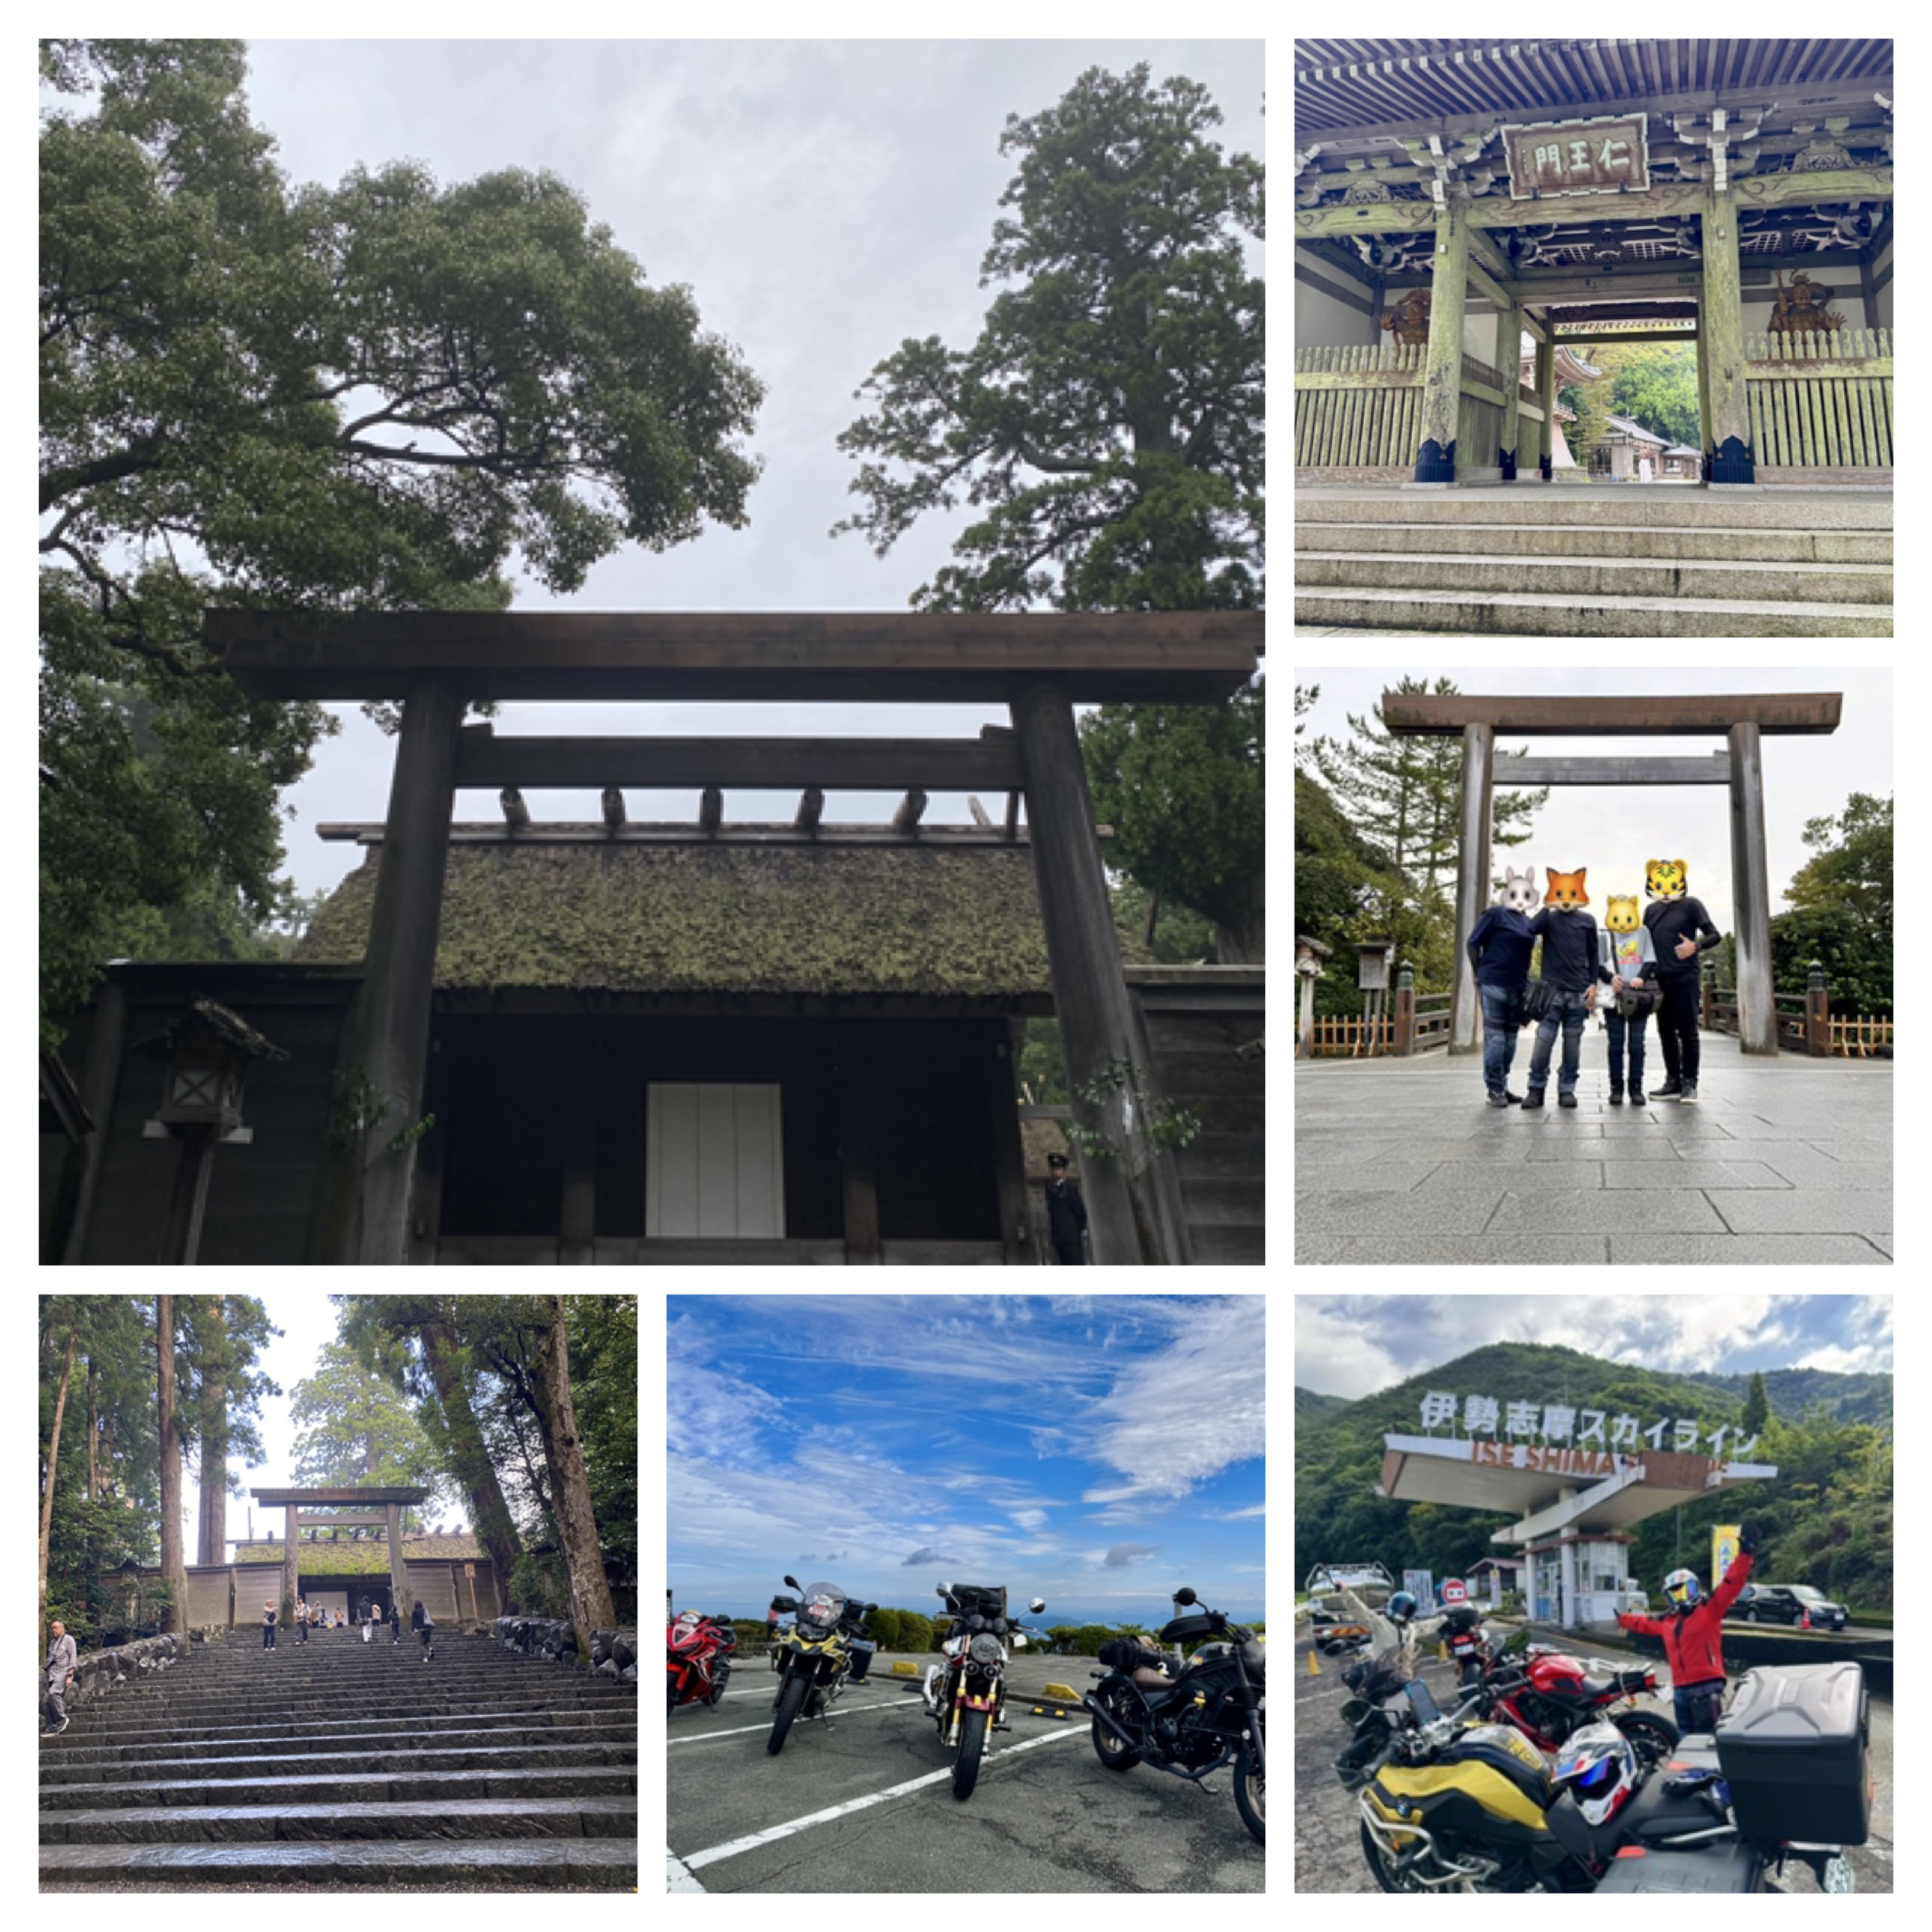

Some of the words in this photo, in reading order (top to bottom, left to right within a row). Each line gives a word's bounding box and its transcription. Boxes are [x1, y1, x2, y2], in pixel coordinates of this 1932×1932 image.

[1419, 1390, 1760, 1454] 伊勢志摩スカイライン
[1472, 1441, 1514, 1468] ISE
[1525, 1445, 1617, 1475] SHIMA
